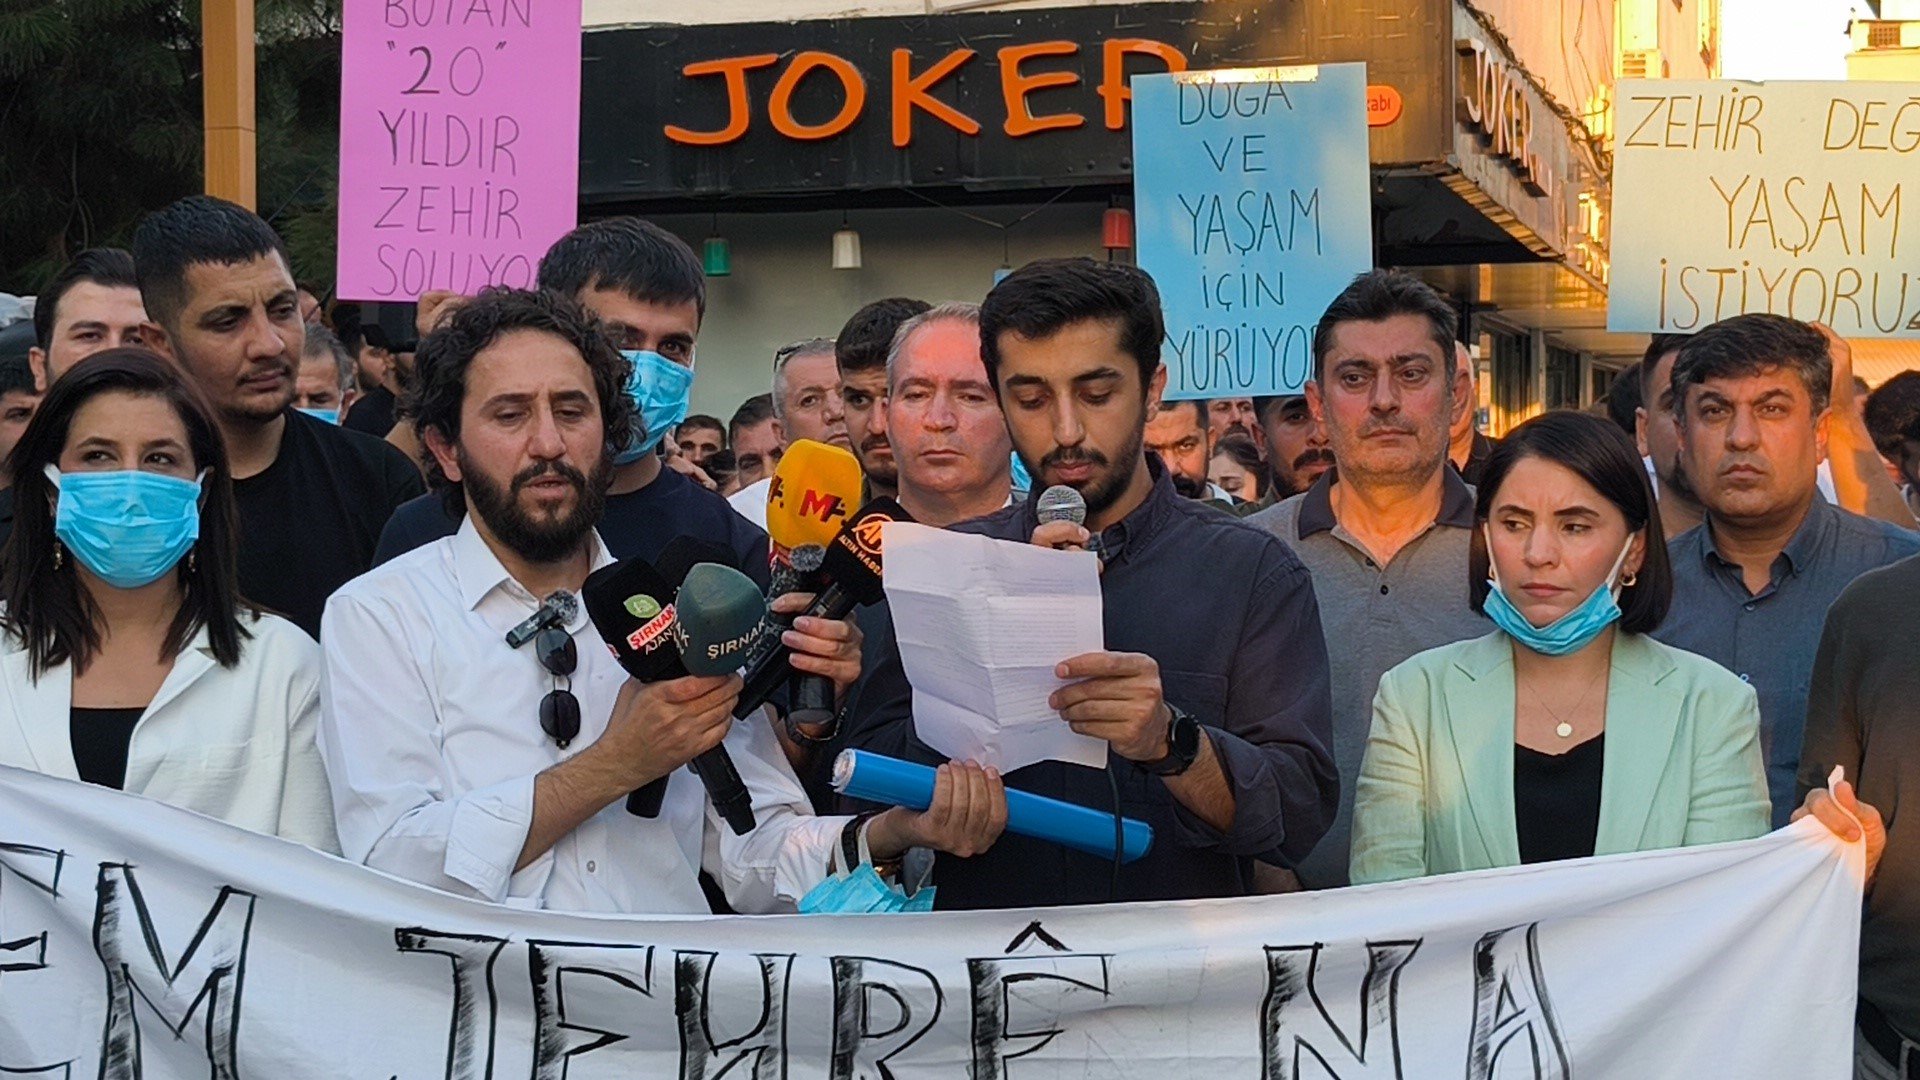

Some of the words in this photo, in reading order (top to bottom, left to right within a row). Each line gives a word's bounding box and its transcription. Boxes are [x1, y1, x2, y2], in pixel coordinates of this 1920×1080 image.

[386, 40, 507, 97] "20"
[663, 38, 1188, 148] JOKER
[1366, 94, 1391, 112] abı
[1454, 38, 1540, 187] JOKER
[1624, 86, 1763, 154] ZEHİR
[378, 108, 517, 177] YILDIR
[1202, 134, 1266, 172] VE
[373, 180, 522, 240] ZEHİR
[1177, 187, 1322, 256] YAŞAM
[1708, 174, 1900, 260] YAŞAM
[371, 244, 540, 297] SOLUYO
[1201, 265, 1285, 312] İÇİN
[629, 603, 676, 651] ŞIRNAK
